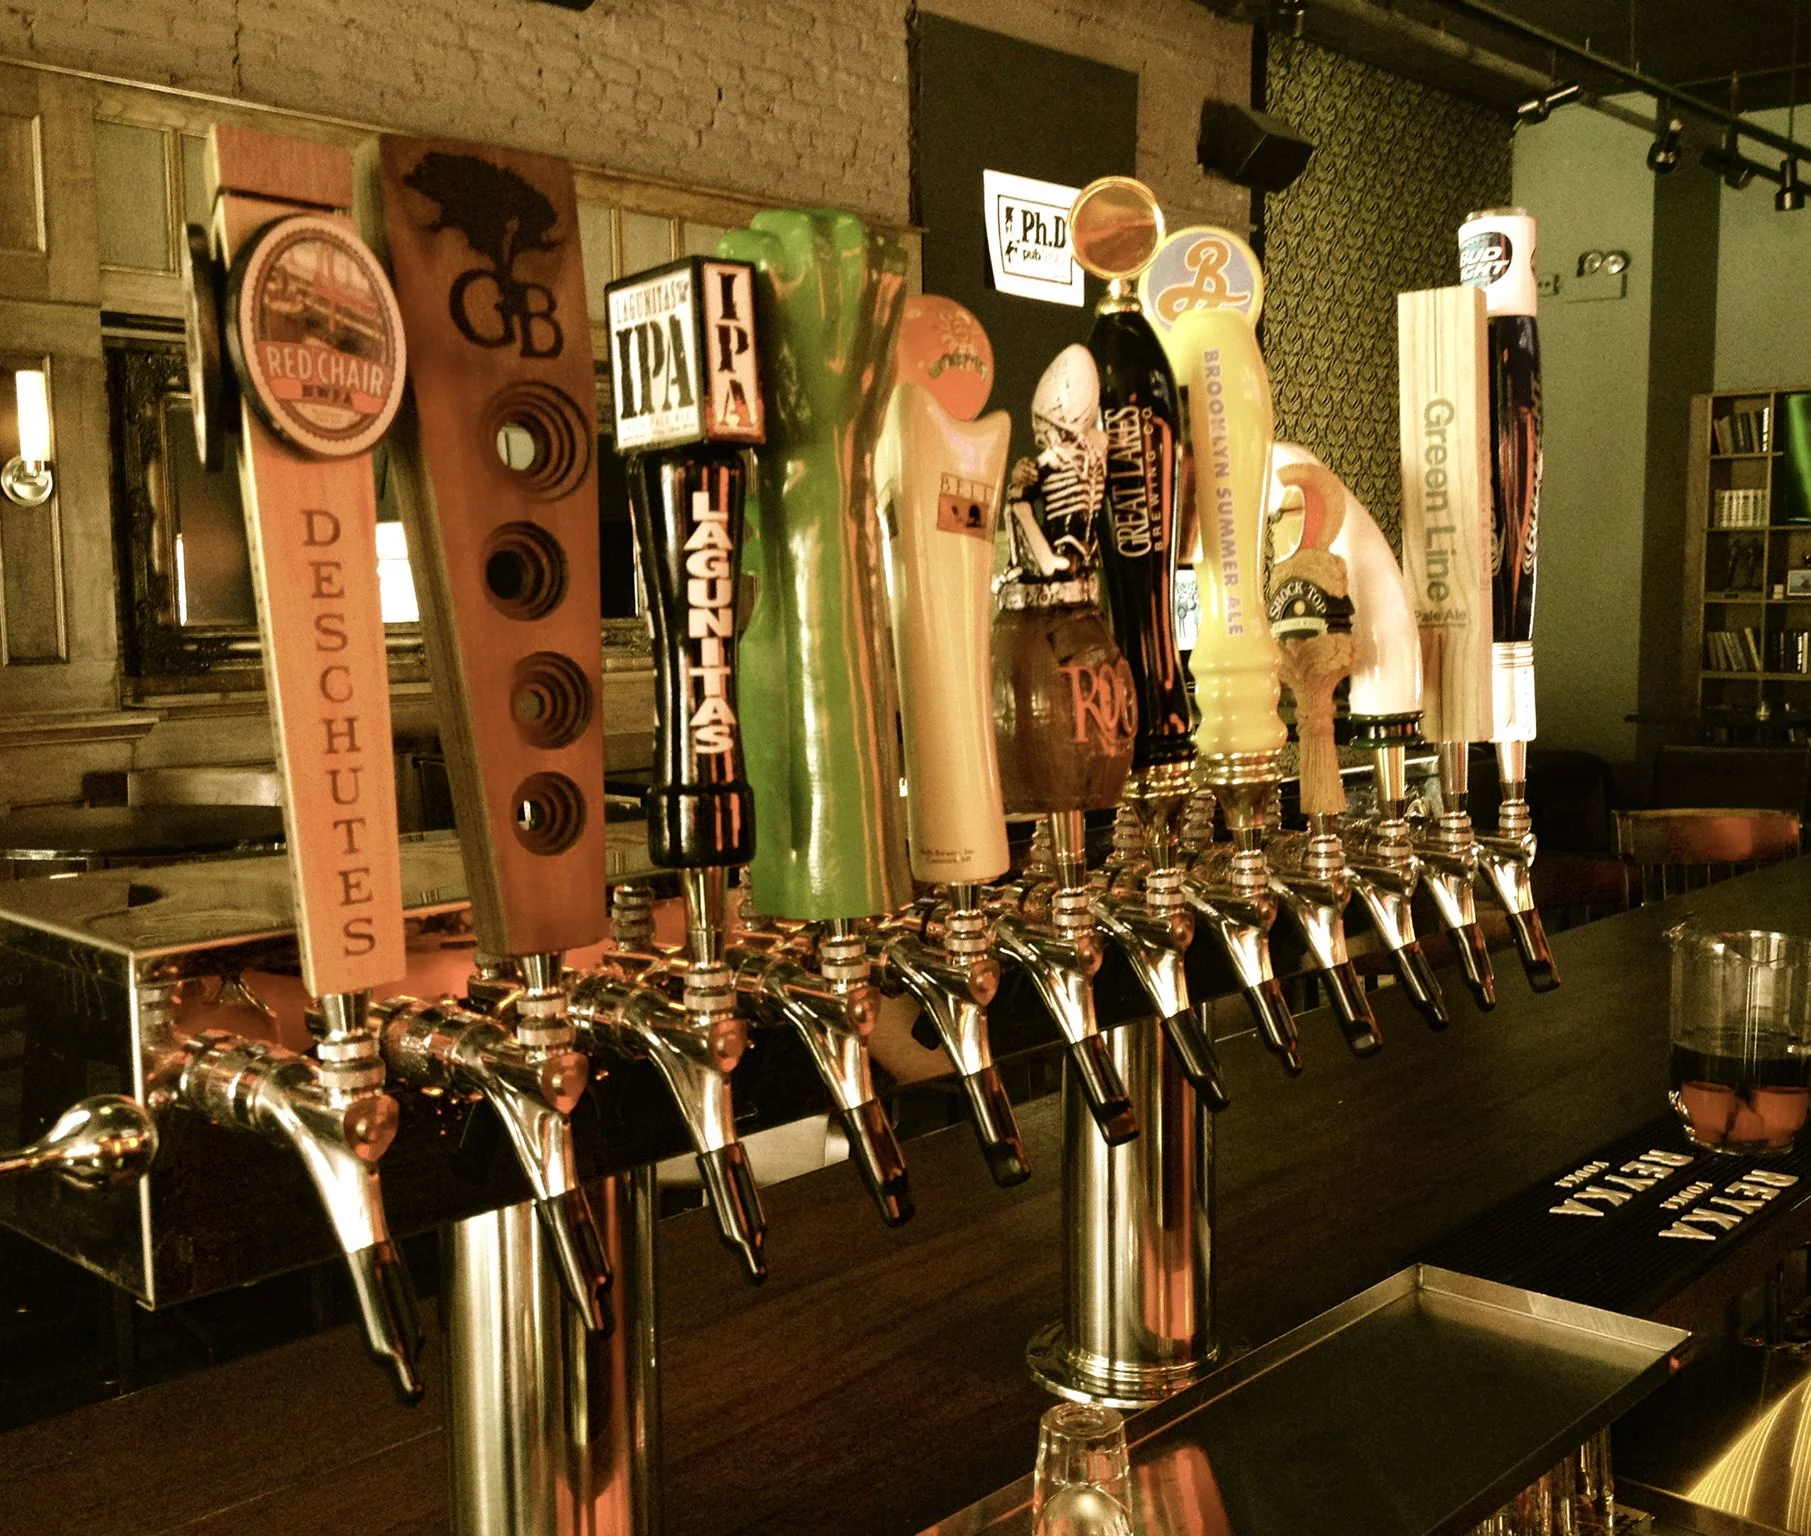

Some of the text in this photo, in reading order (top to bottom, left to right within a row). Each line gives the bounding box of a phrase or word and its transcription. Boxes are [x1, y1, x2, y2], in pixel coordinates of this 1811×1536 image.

[266, 346, 384, 396] RED CHAIR
[616, 315, 694, 419] IPA
[715, 272, 755, 427] IPA
[1104, 405, 1151, 558] GREAT LAKES
[1144, 450, 1163, 552] BREWING
[1204, 350, 1244, 636] BROOKLYN SUMMER ALE
[1423, 398, 1457, 603] Green Line
[683, 491, 737, 754] LAGUNITAS
[1270, 580, 1327, 620] SHOCK TOP
[301, 508, 376, 957] DESCHUTES
[1549, 1149, 1695, 1217] REYKA
[1658, 1168, 1800, 1241] REYKA
